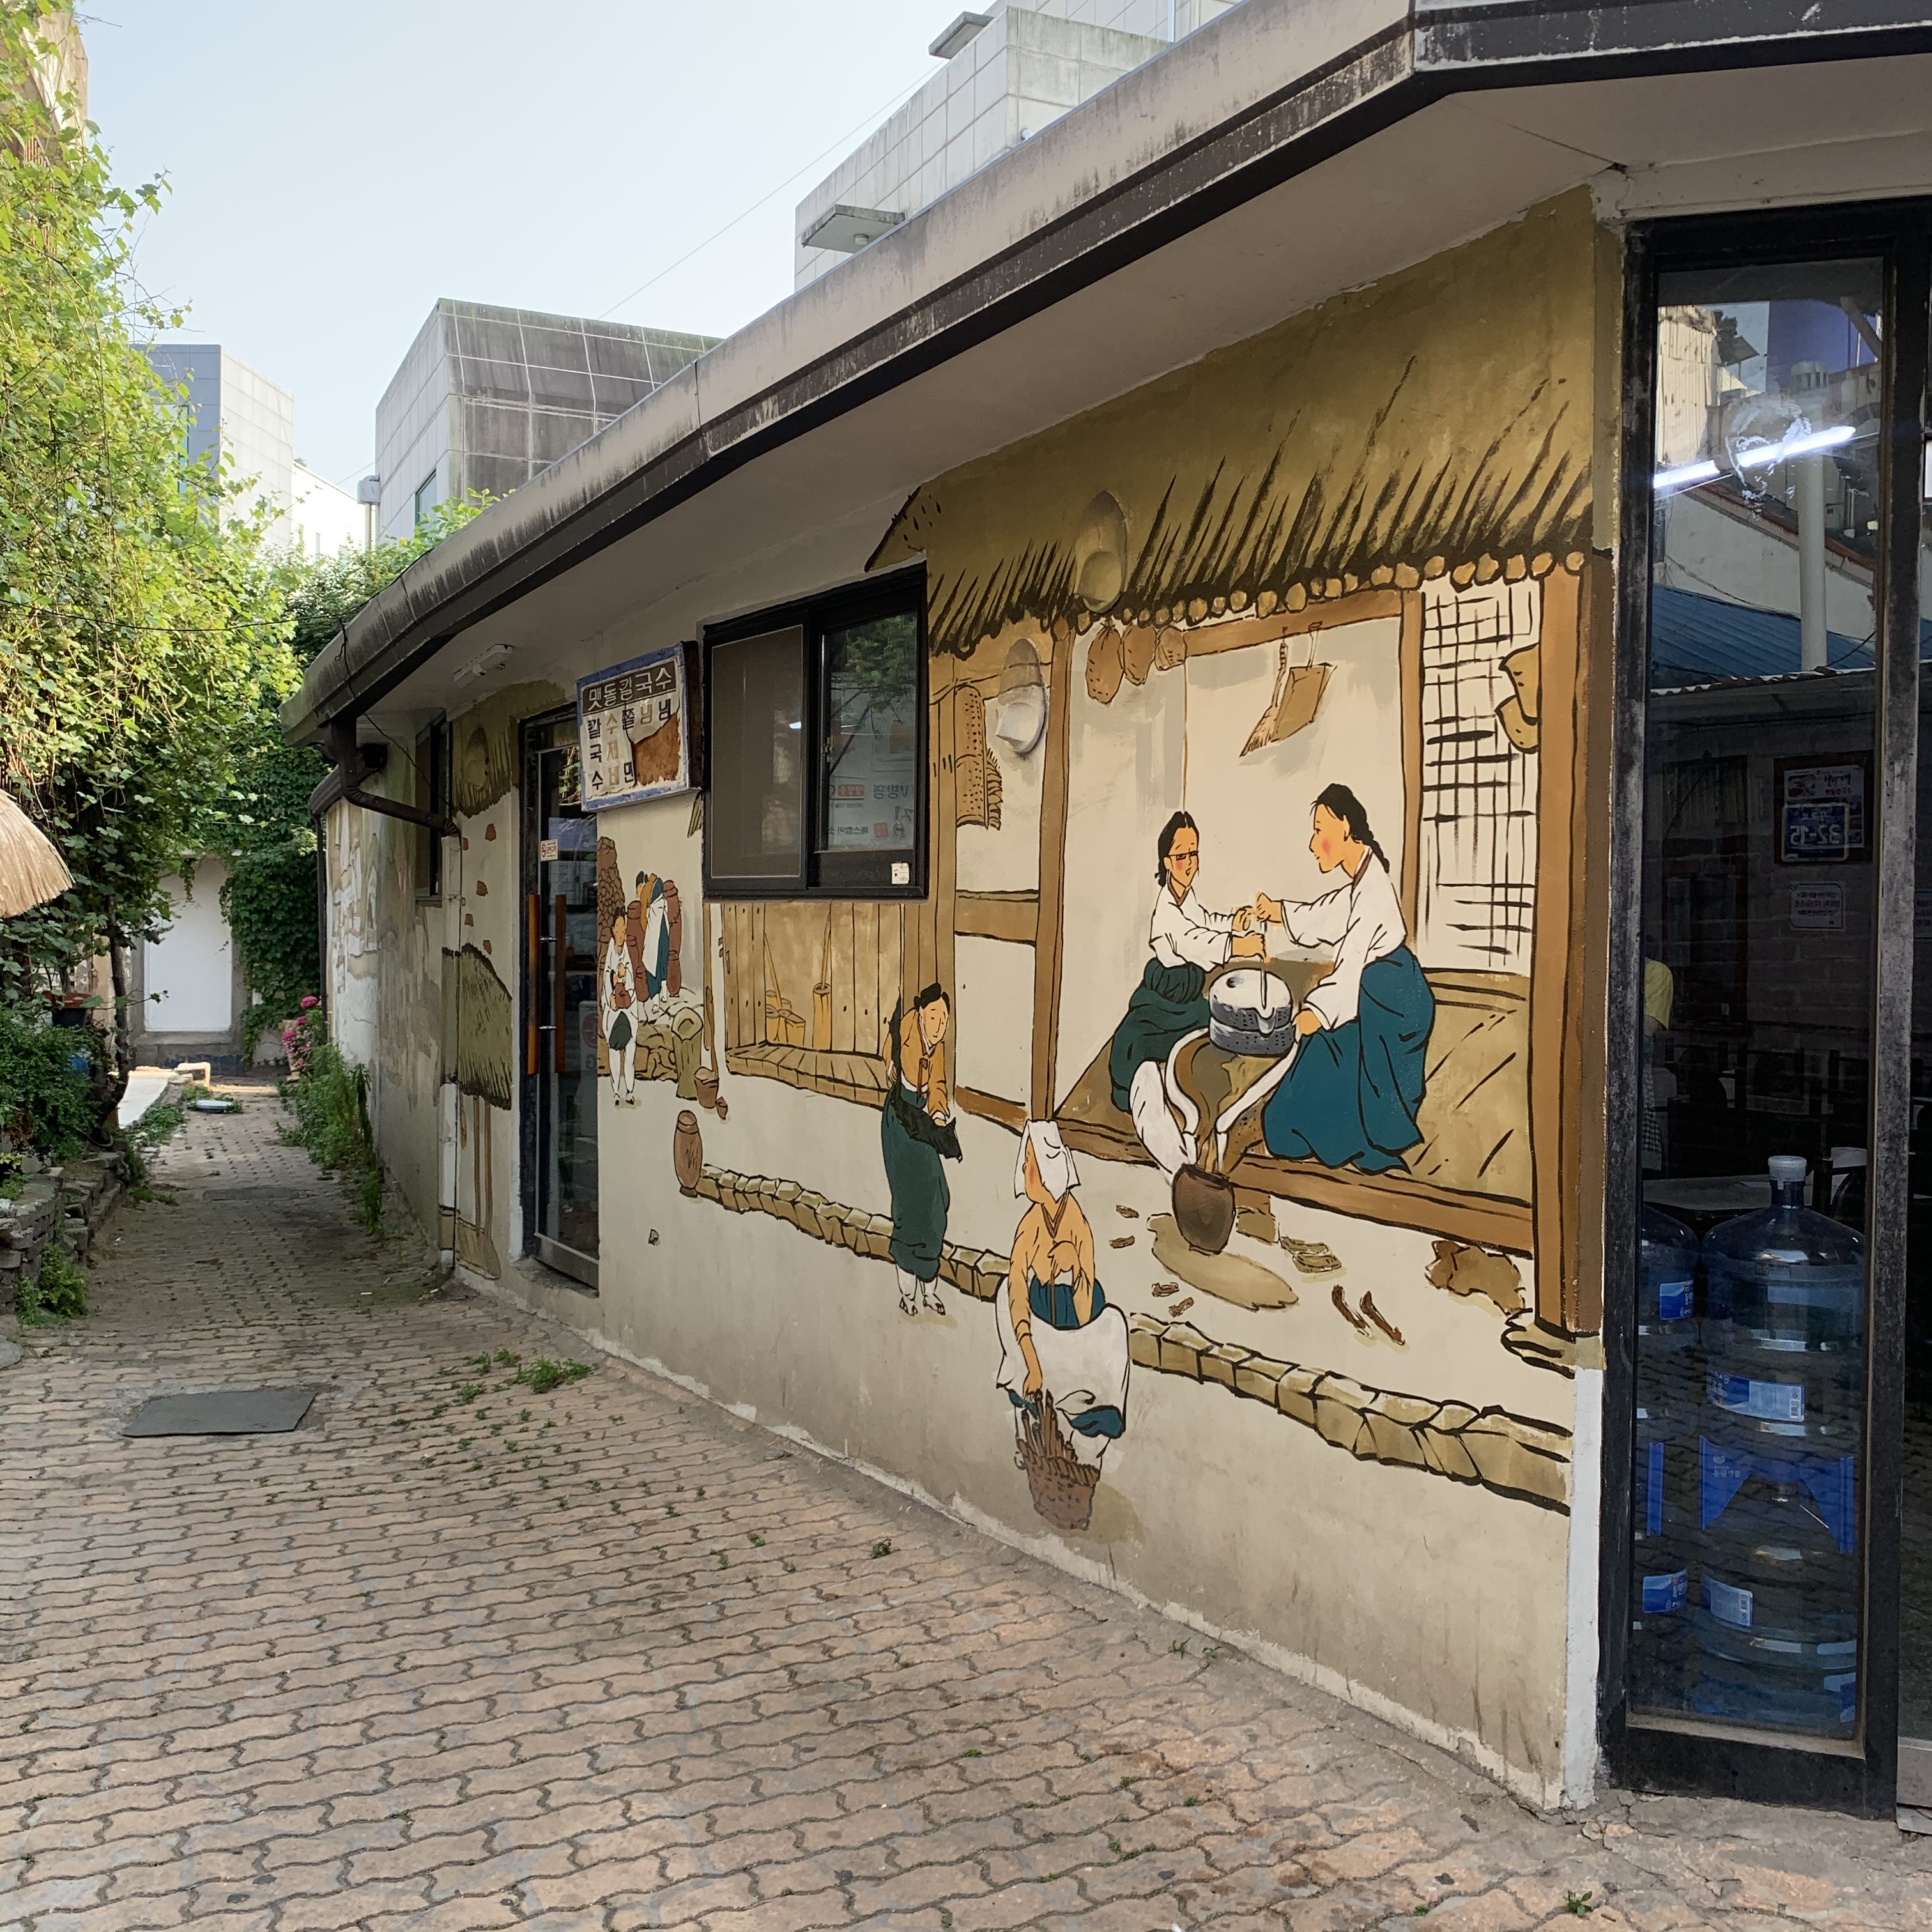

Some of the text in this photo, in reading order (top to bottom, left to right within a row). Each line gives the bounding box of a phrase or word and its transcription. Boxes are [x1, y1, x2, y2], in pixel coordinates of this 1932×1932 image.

[588, 668, 672, 712] 맷돌칼국수
[587, 717, 604, 790] 칼국수
[606, 711, 620, 786] 수제비
